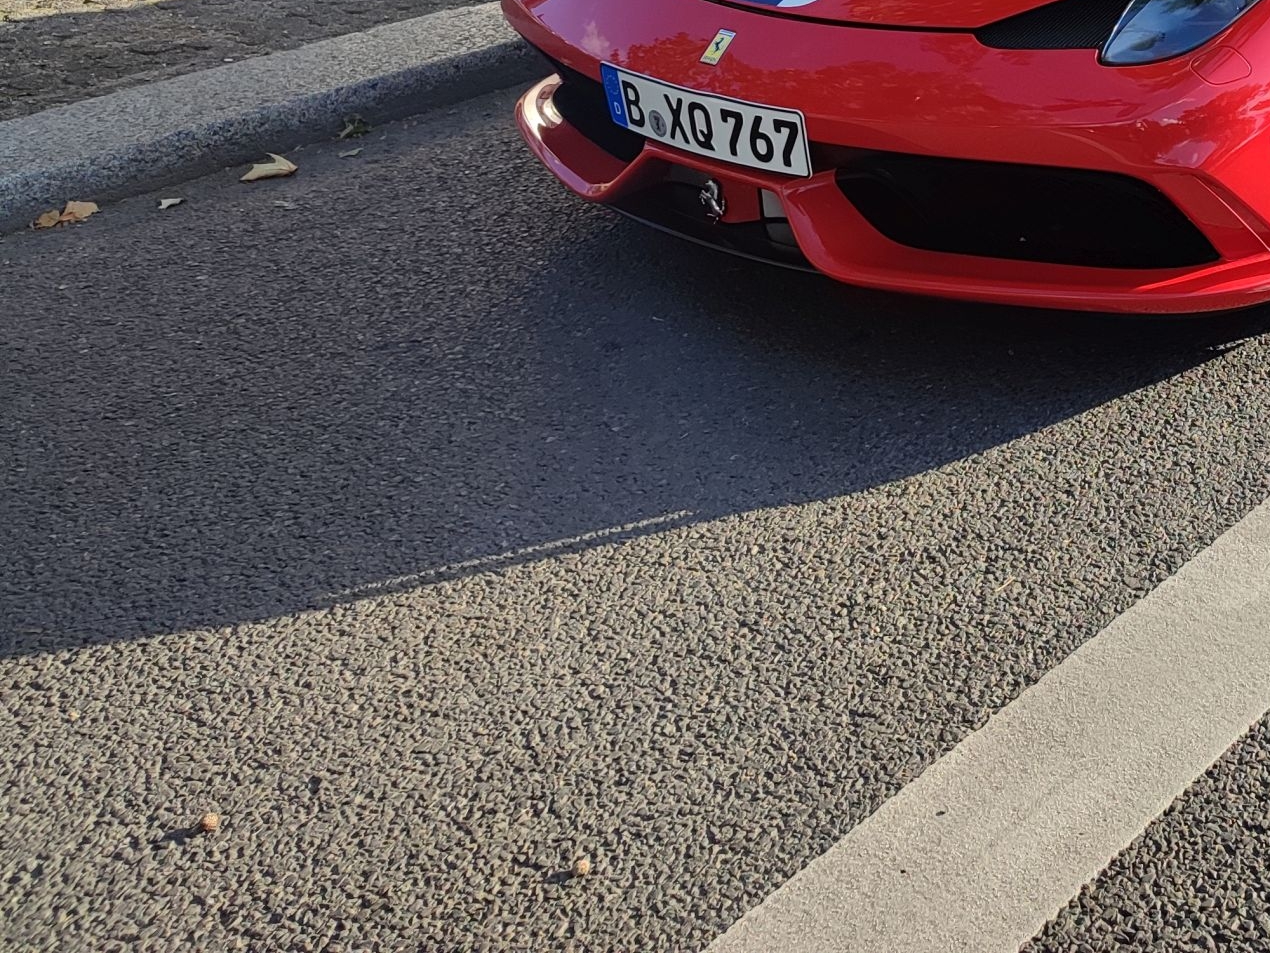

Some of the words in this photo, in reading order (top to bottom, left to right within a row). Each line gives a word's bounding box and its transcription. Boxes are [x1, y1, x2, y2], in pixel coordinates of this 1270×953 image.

[613, 101, 622, 115] D
[621, 79, 646, 128] B
[663, 93, 715, 152] XQ
[719, 108, 799, 168] 767
